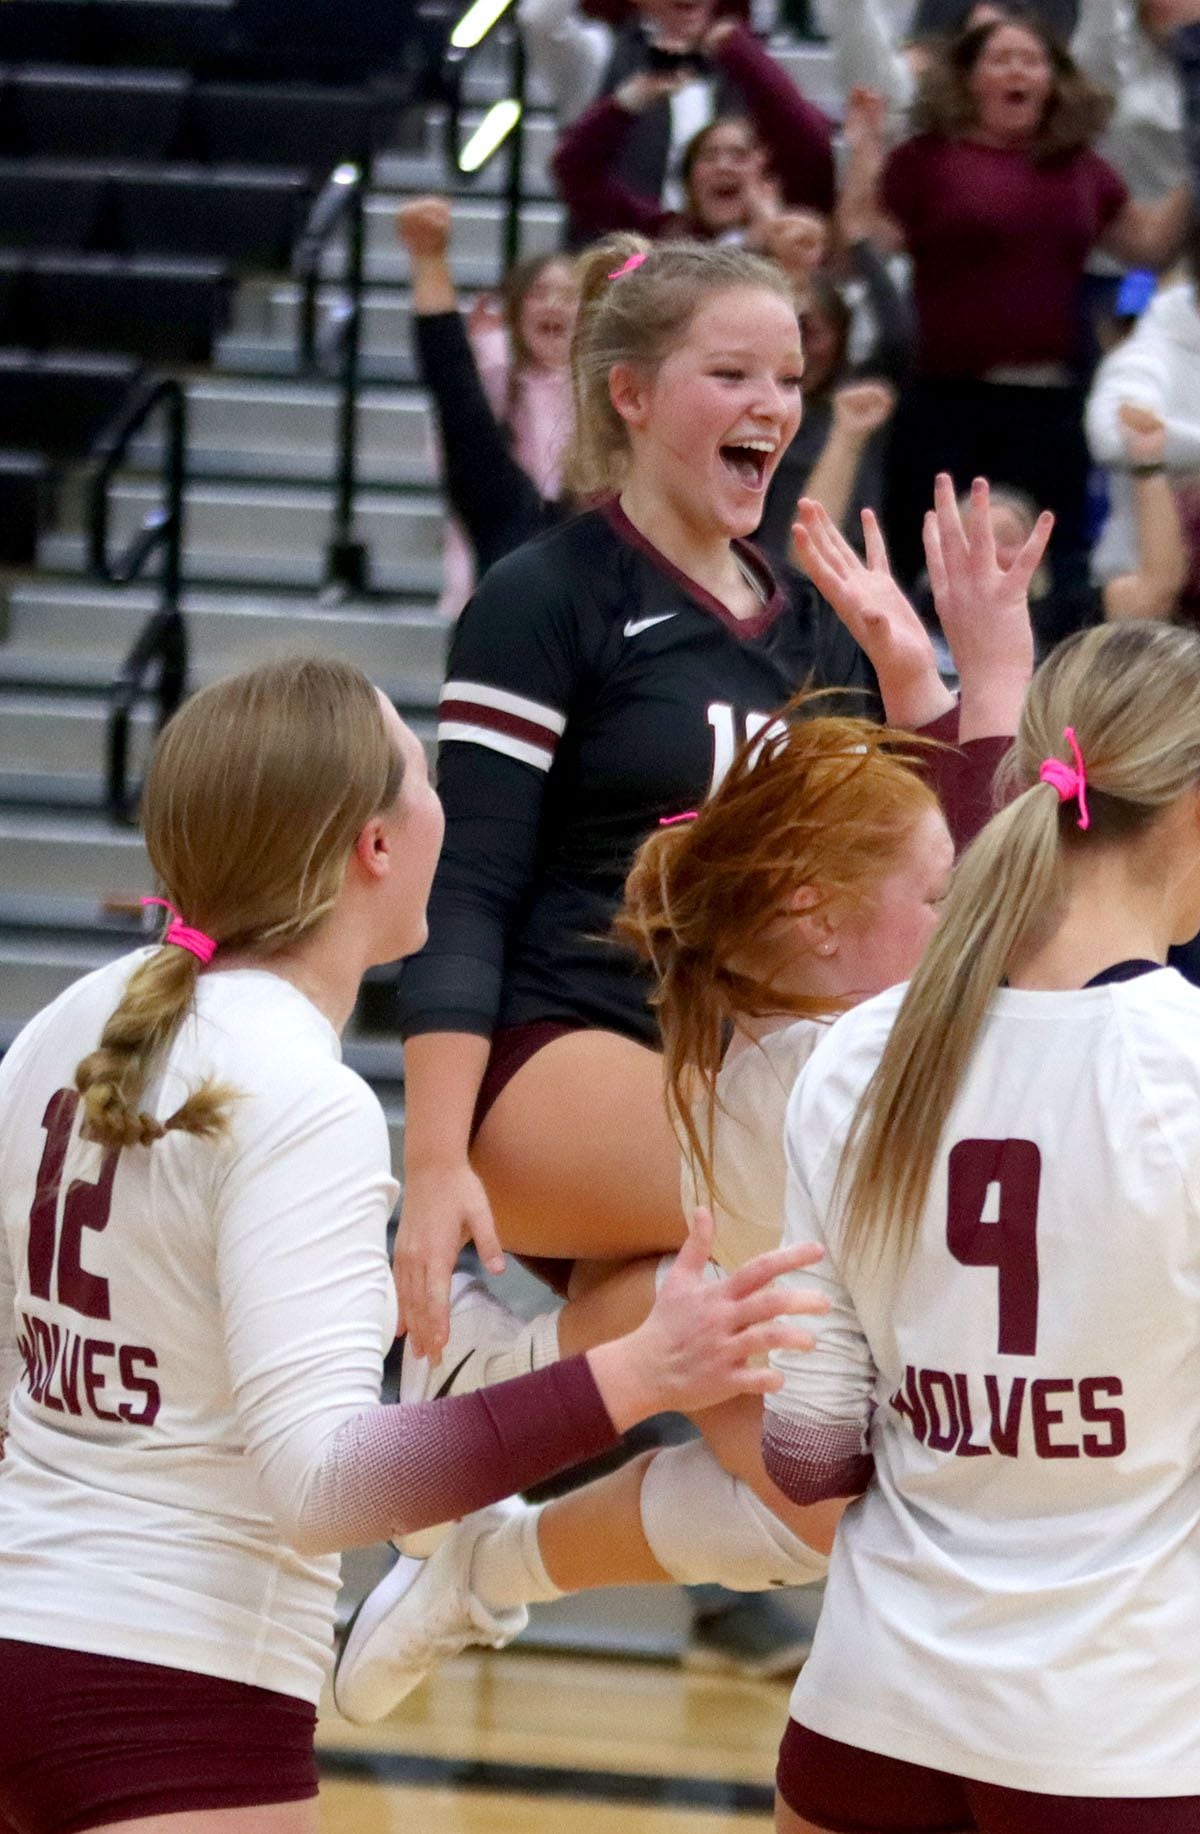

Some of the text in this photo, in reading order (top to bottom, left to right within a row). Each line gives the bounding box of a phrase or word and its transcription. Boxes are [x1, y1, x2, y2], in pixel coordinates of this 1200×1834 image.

[707, 703, 790, 801] 1
[28, 1088, 122, 1320] 12
[946, 1138, 1041, 1356] 9
